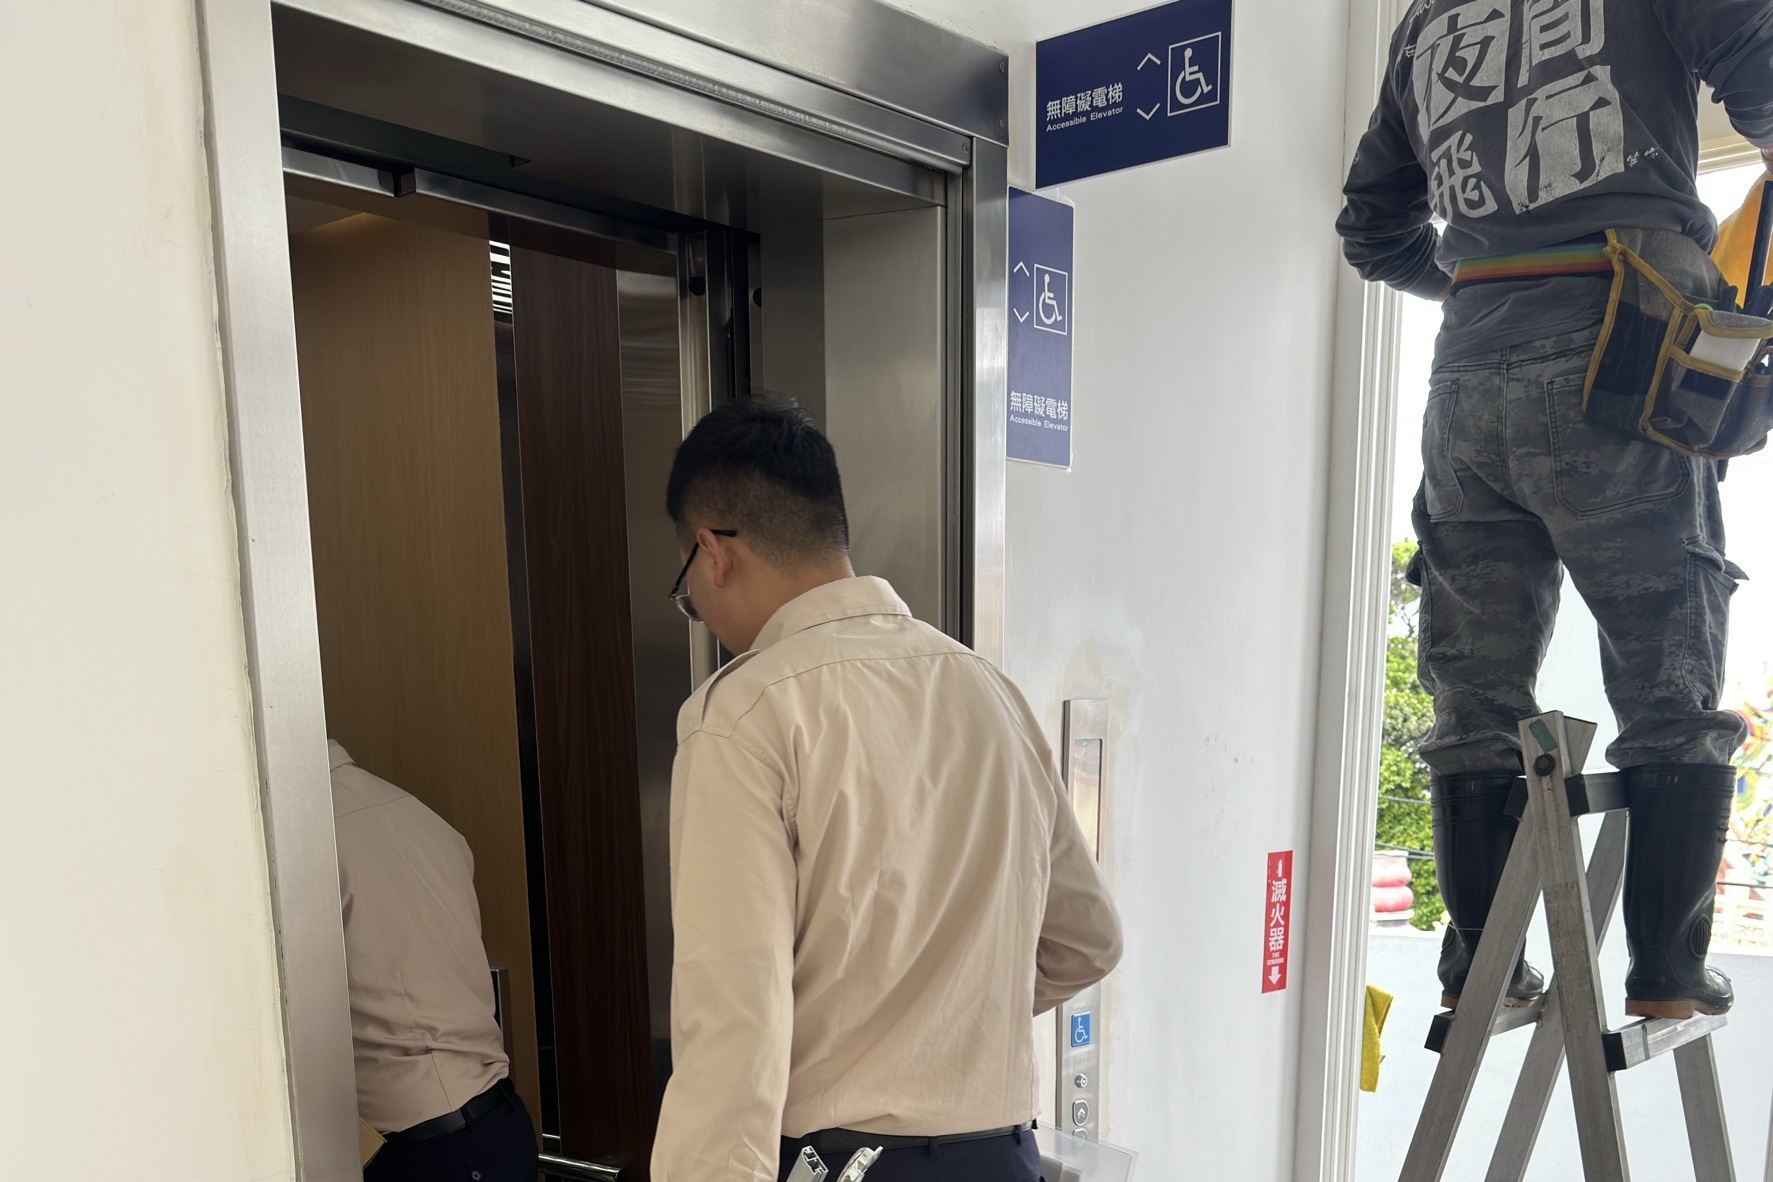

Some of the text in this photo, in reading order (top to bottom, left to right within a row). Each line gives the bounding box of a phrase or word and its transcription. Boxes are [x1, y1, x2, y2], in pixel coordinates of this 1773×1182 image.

[1046, 82, 1123, 121] 無障礙電梯
[1046, 106, 1124, 132] Accessible Elevator
[1010, 390, 1068, 420] 無障礙電梯
[1010, 414, 1069, 431] Accessible Elevator
[1269, 878, 1288, 952] 滅火器
